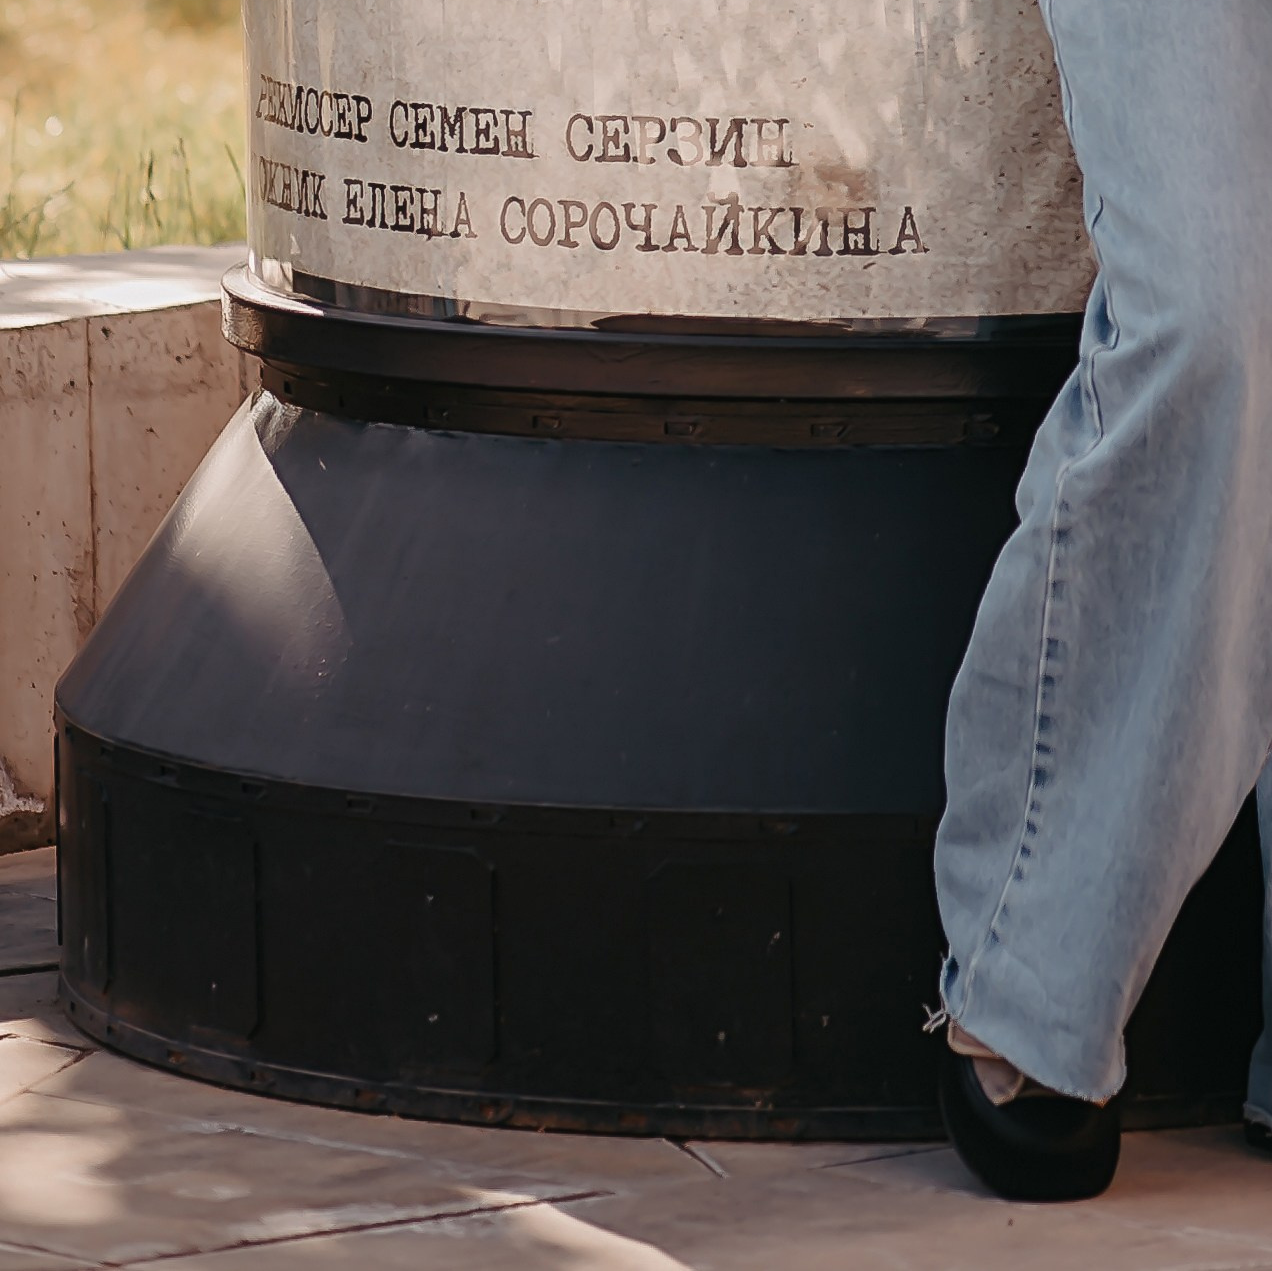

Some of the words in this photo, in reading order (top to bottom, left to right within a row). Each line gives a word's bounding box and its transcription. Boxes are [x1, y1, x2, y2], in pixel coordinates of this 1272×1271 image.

[389, 99, 539, 159] СЕМЕН
[565, 113, 800, 169] СЕРЗИН
[251, 153, 329, 221] ОЖНИК
[341, 177, 479, 241] ЕЛЕНА
[500, 191, 930, 256] СОРОЧАЙКИНА
